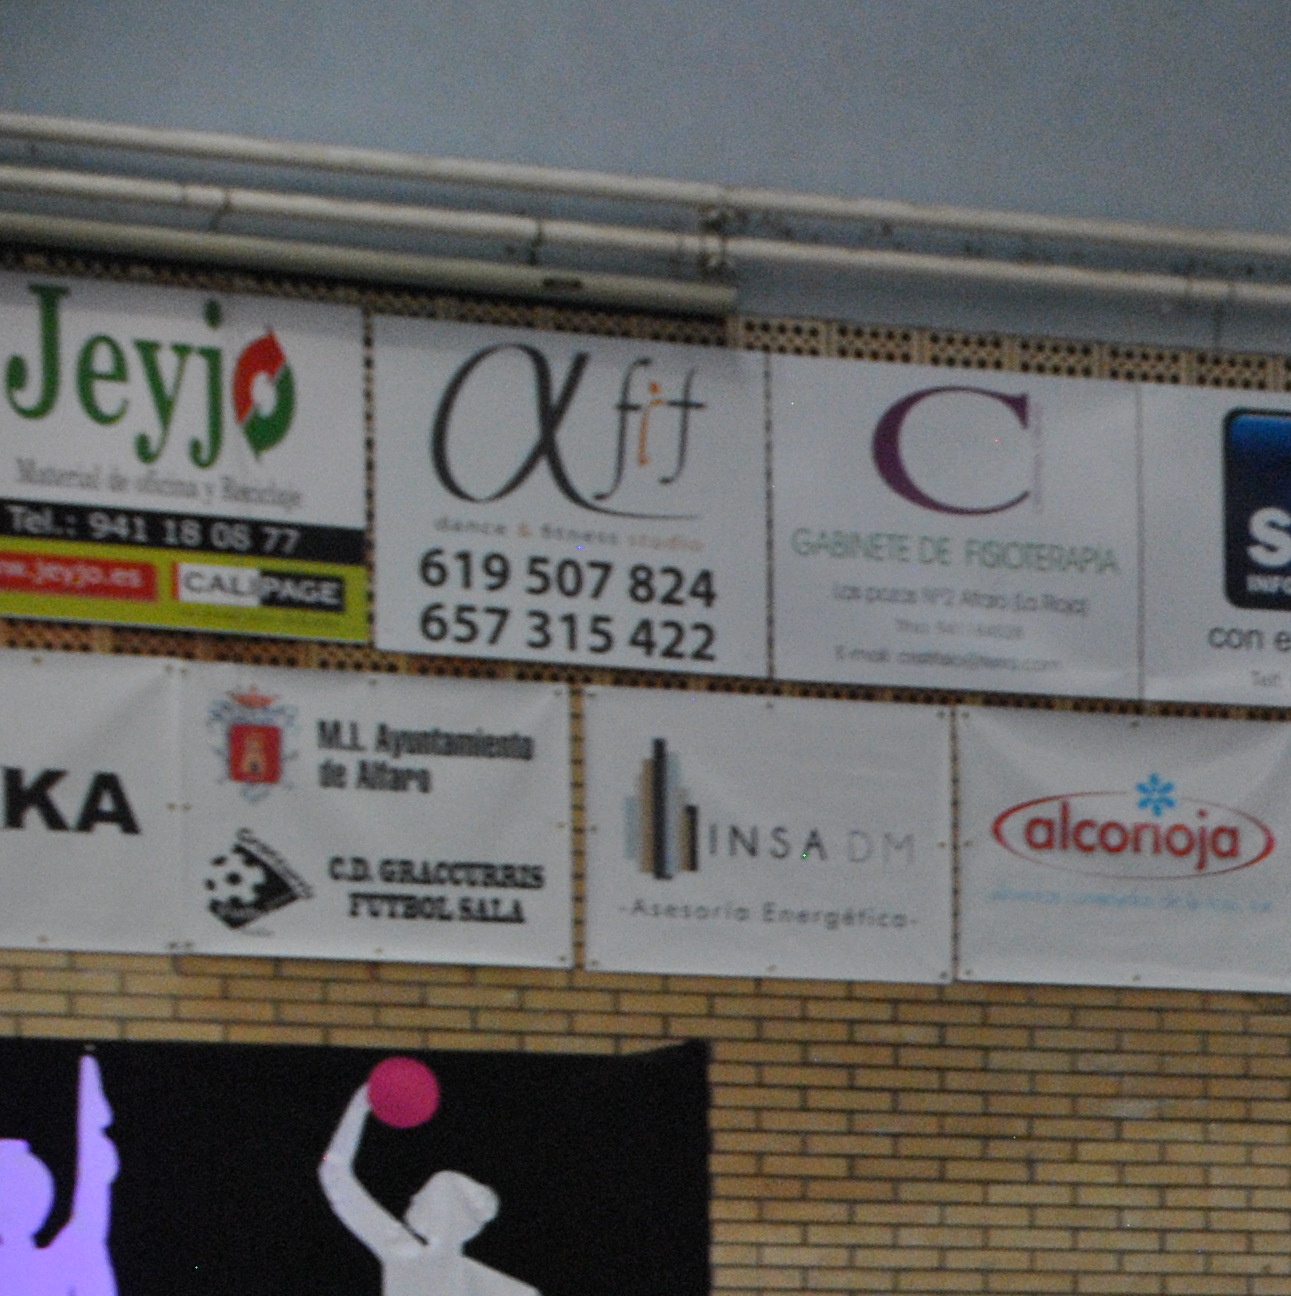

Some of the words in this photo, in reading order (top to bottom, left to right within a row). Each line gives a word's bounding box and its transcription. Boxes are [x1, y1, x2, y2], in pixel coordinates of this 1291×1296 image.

[88, 511, 149, 543] 941
[163, 518, 203, 547] 18
[260, 526, 300, 555] 77
[434, 512, 507, 537] dance
[541, 521, 621, 547] fitness
[627, 530, 702, 553] studio
[790, 526, 915, 565] GABINETE
[919, 535, 952, 567] DE
[965, 538, 1121, 576] FISIOTERAPIA
[419, 547, 511, 591] 619
[524, 556, 613, 600] 507
[627, 564, 717, 609] 824
[419, 602, 510, 646] 657
[525, 609, 614, 655] 315
[627, 618, 716, 663] 422
[1208, 626, 1265, 650] con
[374, 721, 537, 762] Ayuntamiento
[318, 758, 347, 789] de
[356, 759, 432, 794] Alfaro
[4, 765, 141, 836] KA
[708, 823, 828, 861] INSA
[845, 828, 917, 866] DM
[1025, 799, 1239, 871] alconoja
[457, 895, 526, 924] SALA
